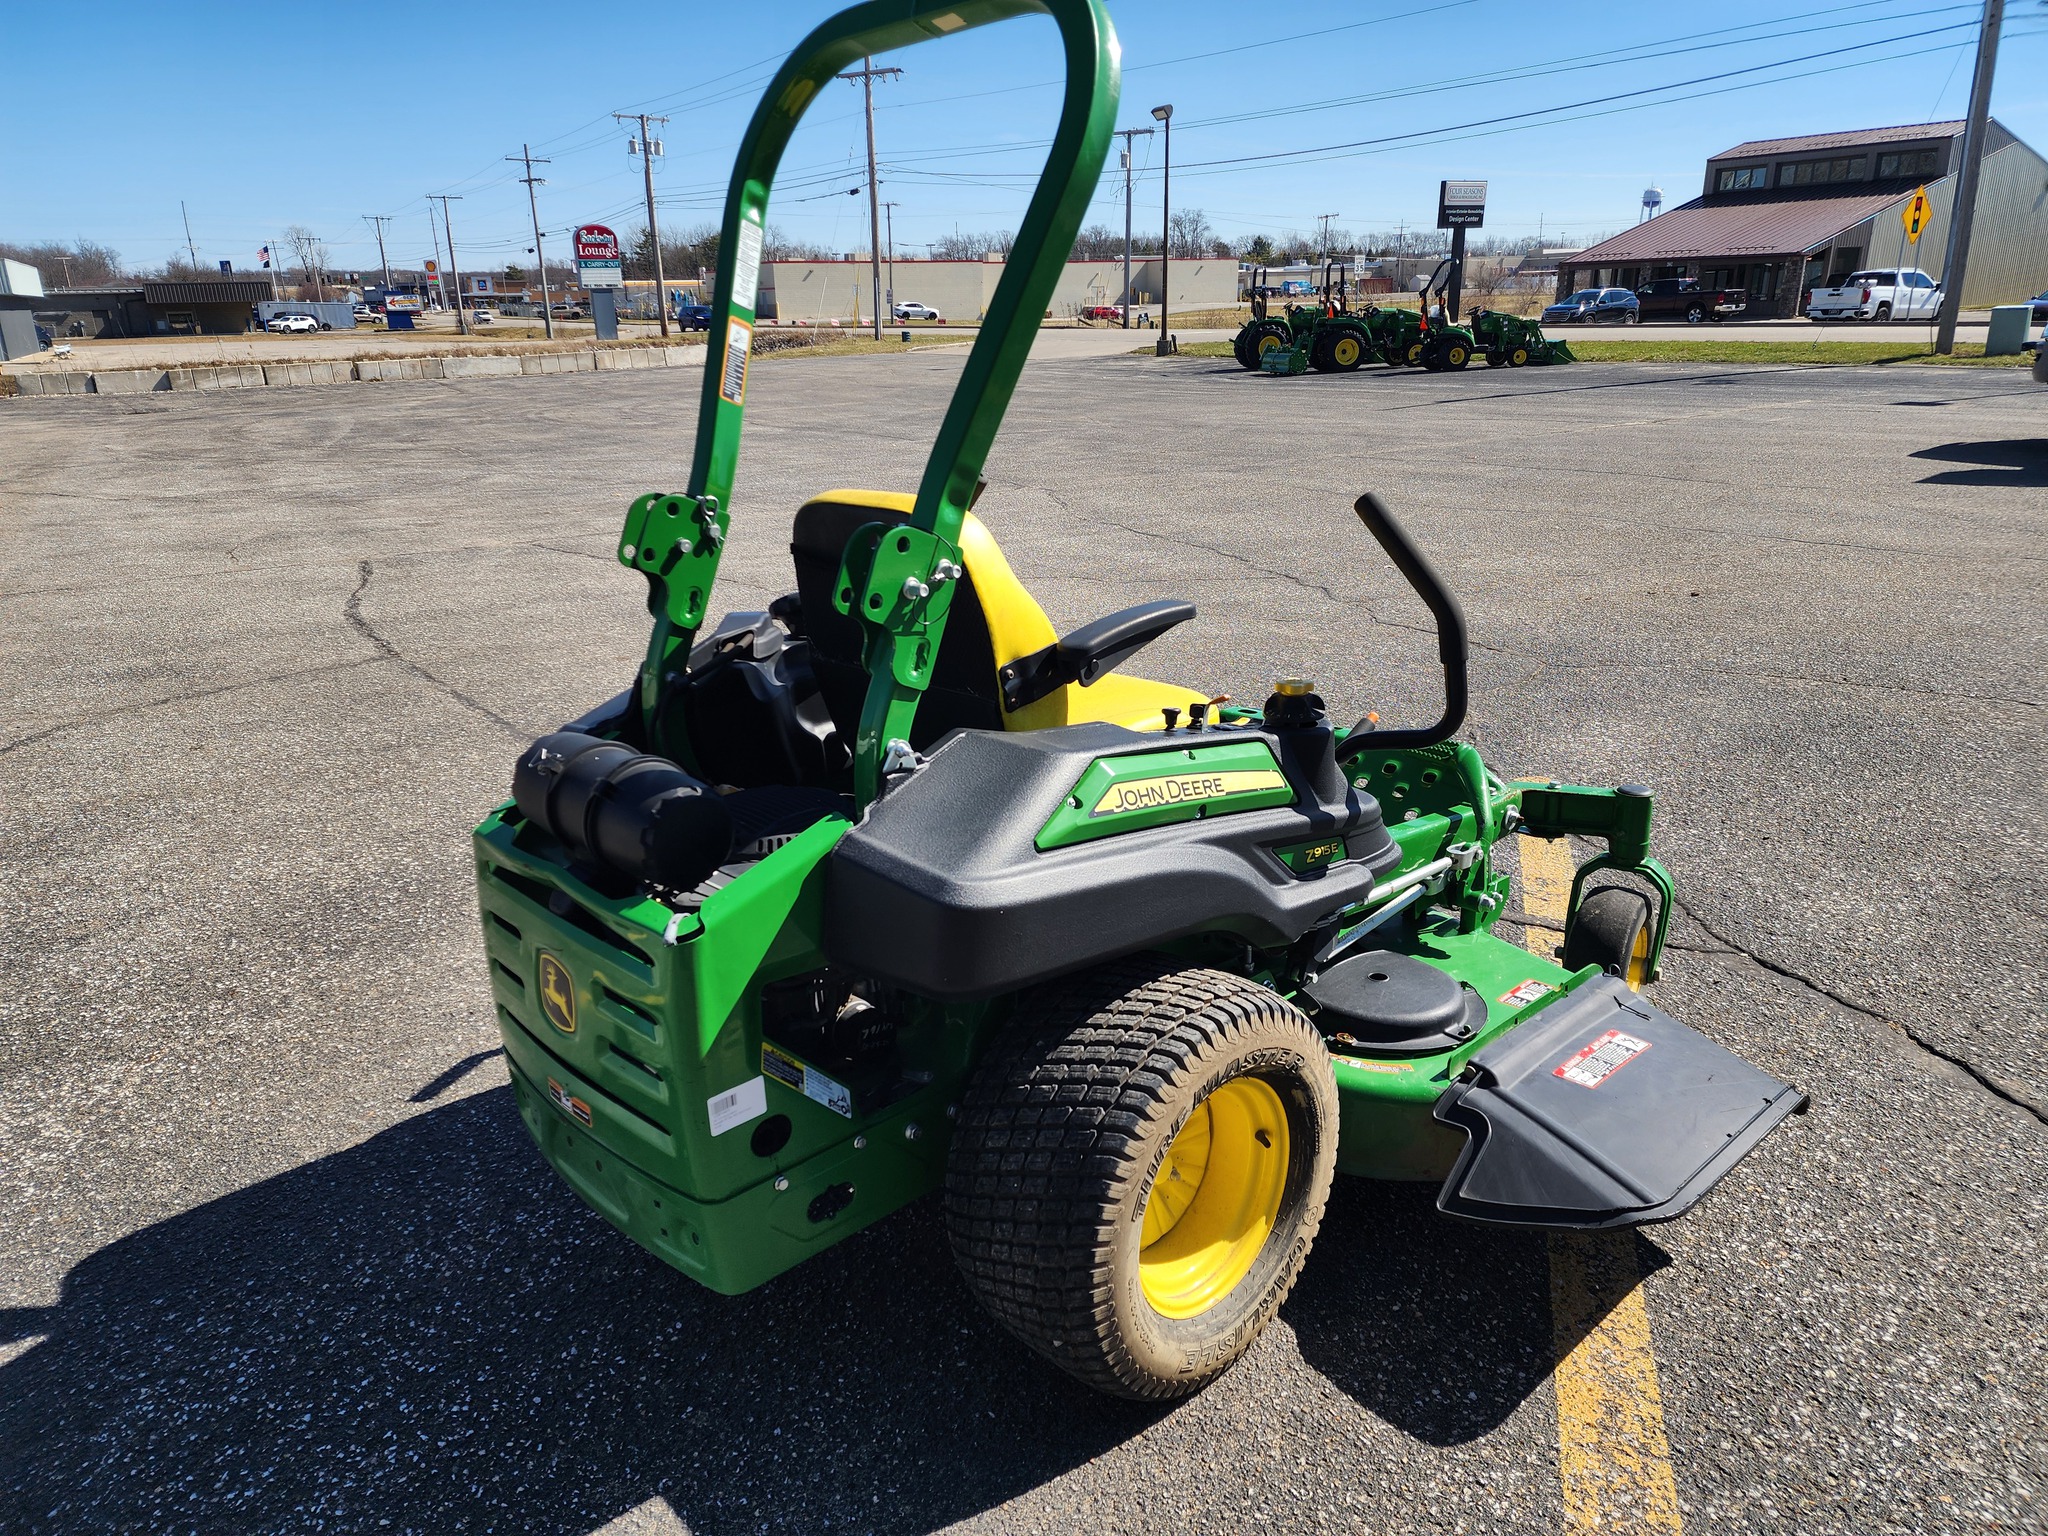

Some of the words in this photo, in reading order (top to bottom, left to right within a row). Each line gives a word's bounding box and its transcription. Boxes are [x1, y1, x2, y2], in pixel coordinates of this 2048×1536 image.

[578, 244, 618, 258] Lounge
[580, 230, 614, 248] Backway
[1355, 264, 1364, 272] 35
[1115, 786, 1165, 809] JOHN
[1166, 778, 1225, 800] DEERE
[1192, 1046, 1306, 1110] MASTER
[1178, 1236, 1307, 1374] CARLISLE
